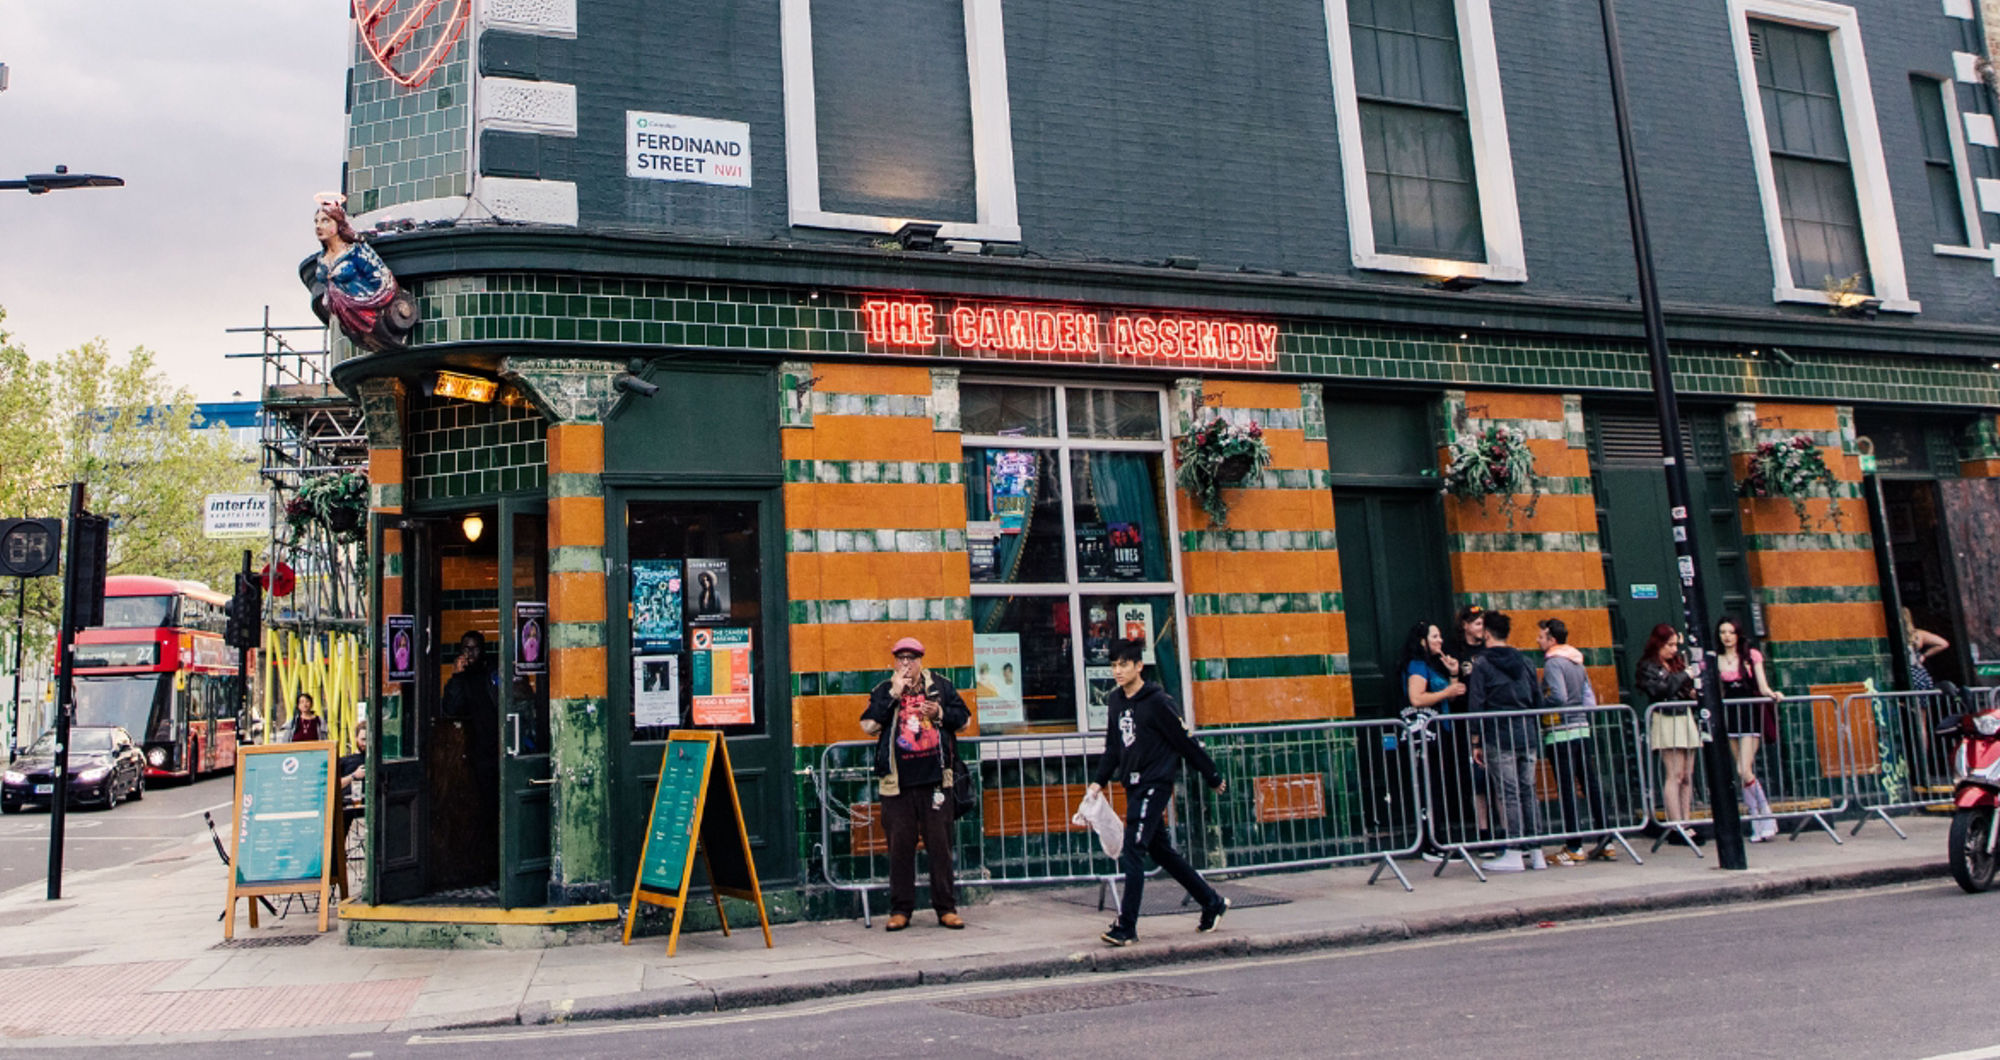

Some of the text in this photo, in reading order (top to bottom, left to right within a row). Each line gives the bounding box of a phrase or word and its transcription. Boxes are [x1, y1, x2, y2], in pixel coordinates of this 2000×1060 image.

[637, 132, 741, 157] FERDINAND
[637, 153, 706, 174] STREET
[714, 164, 742, 177] NW1
[866, 301, 1279, 363] THE CAMDEN ASSEMBLY
[210, 496, 266, 511] interfix
[1125, 608, 1145, 621] elle
[137, 647, 154, 660] 27
